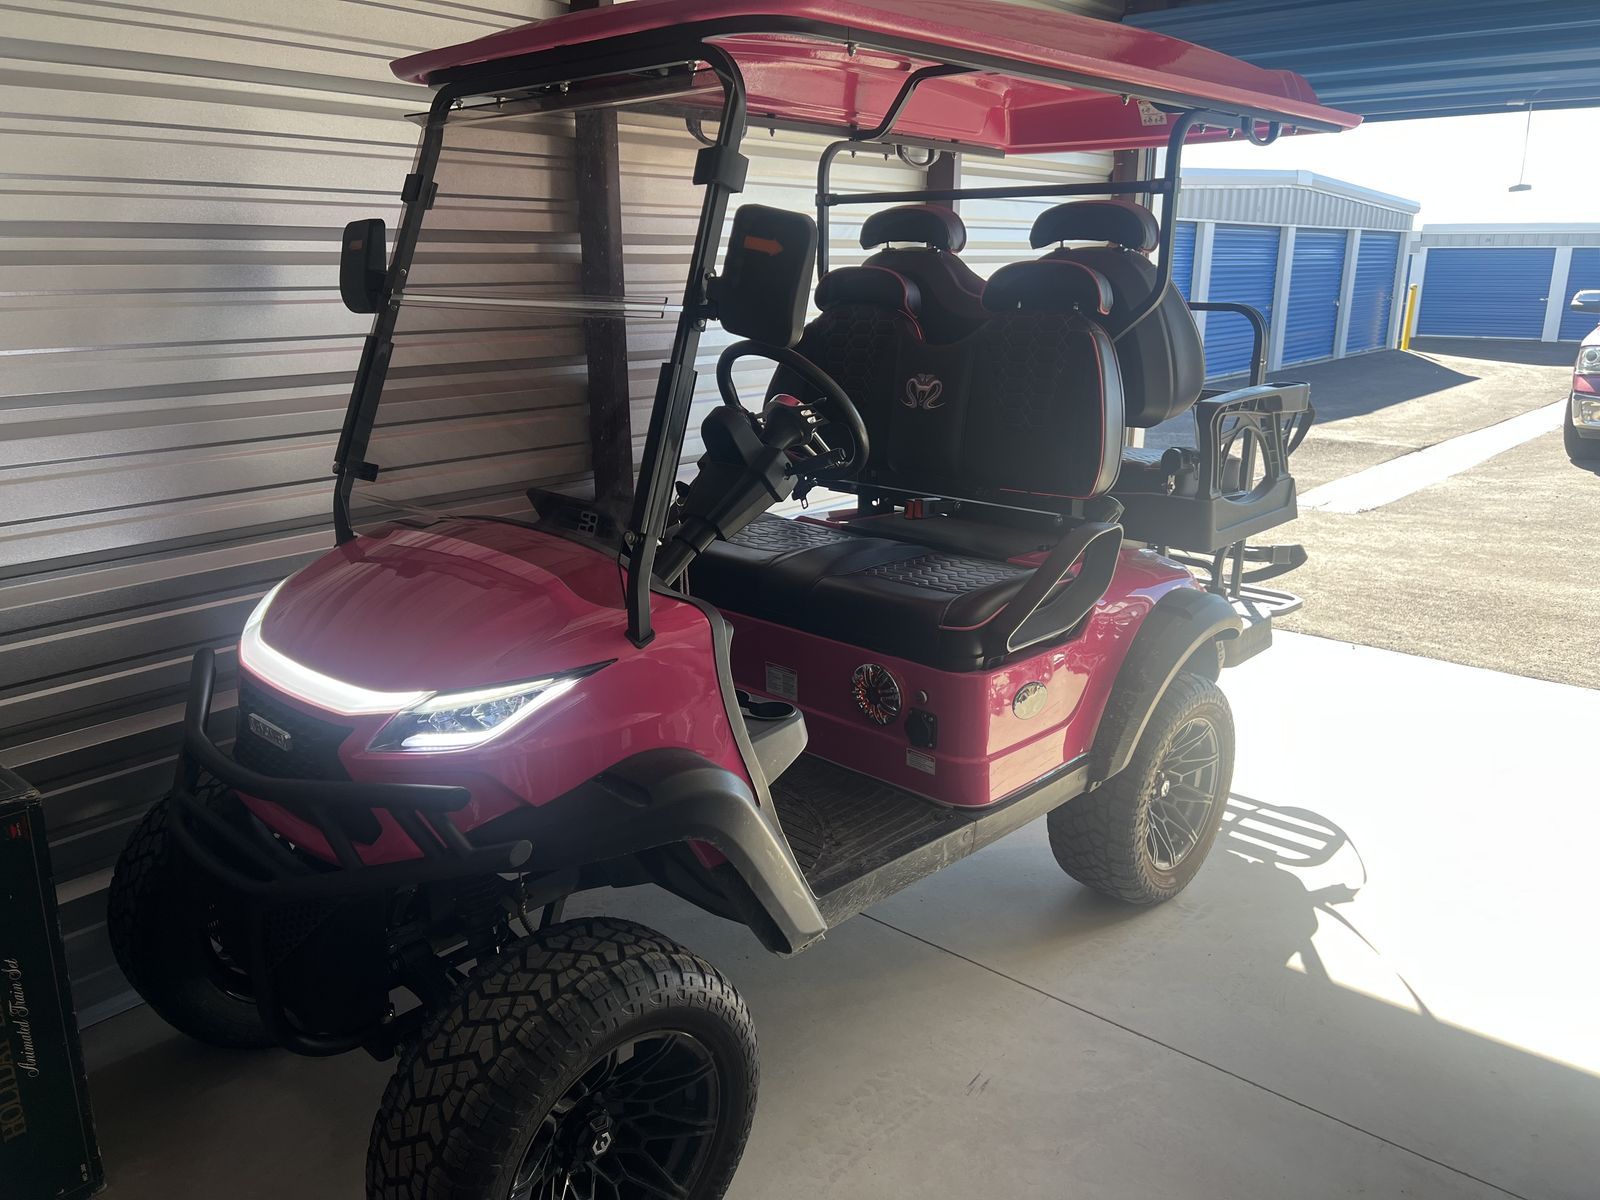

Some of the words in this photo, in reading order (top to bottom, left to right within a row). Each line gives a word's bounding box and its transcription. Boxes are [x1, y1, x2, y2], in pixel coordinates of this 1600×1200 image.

[1, 958, 22, 980] Set
[8, 981, 29, 1017] Train
[12, 1019, 39, 1077] Animated
